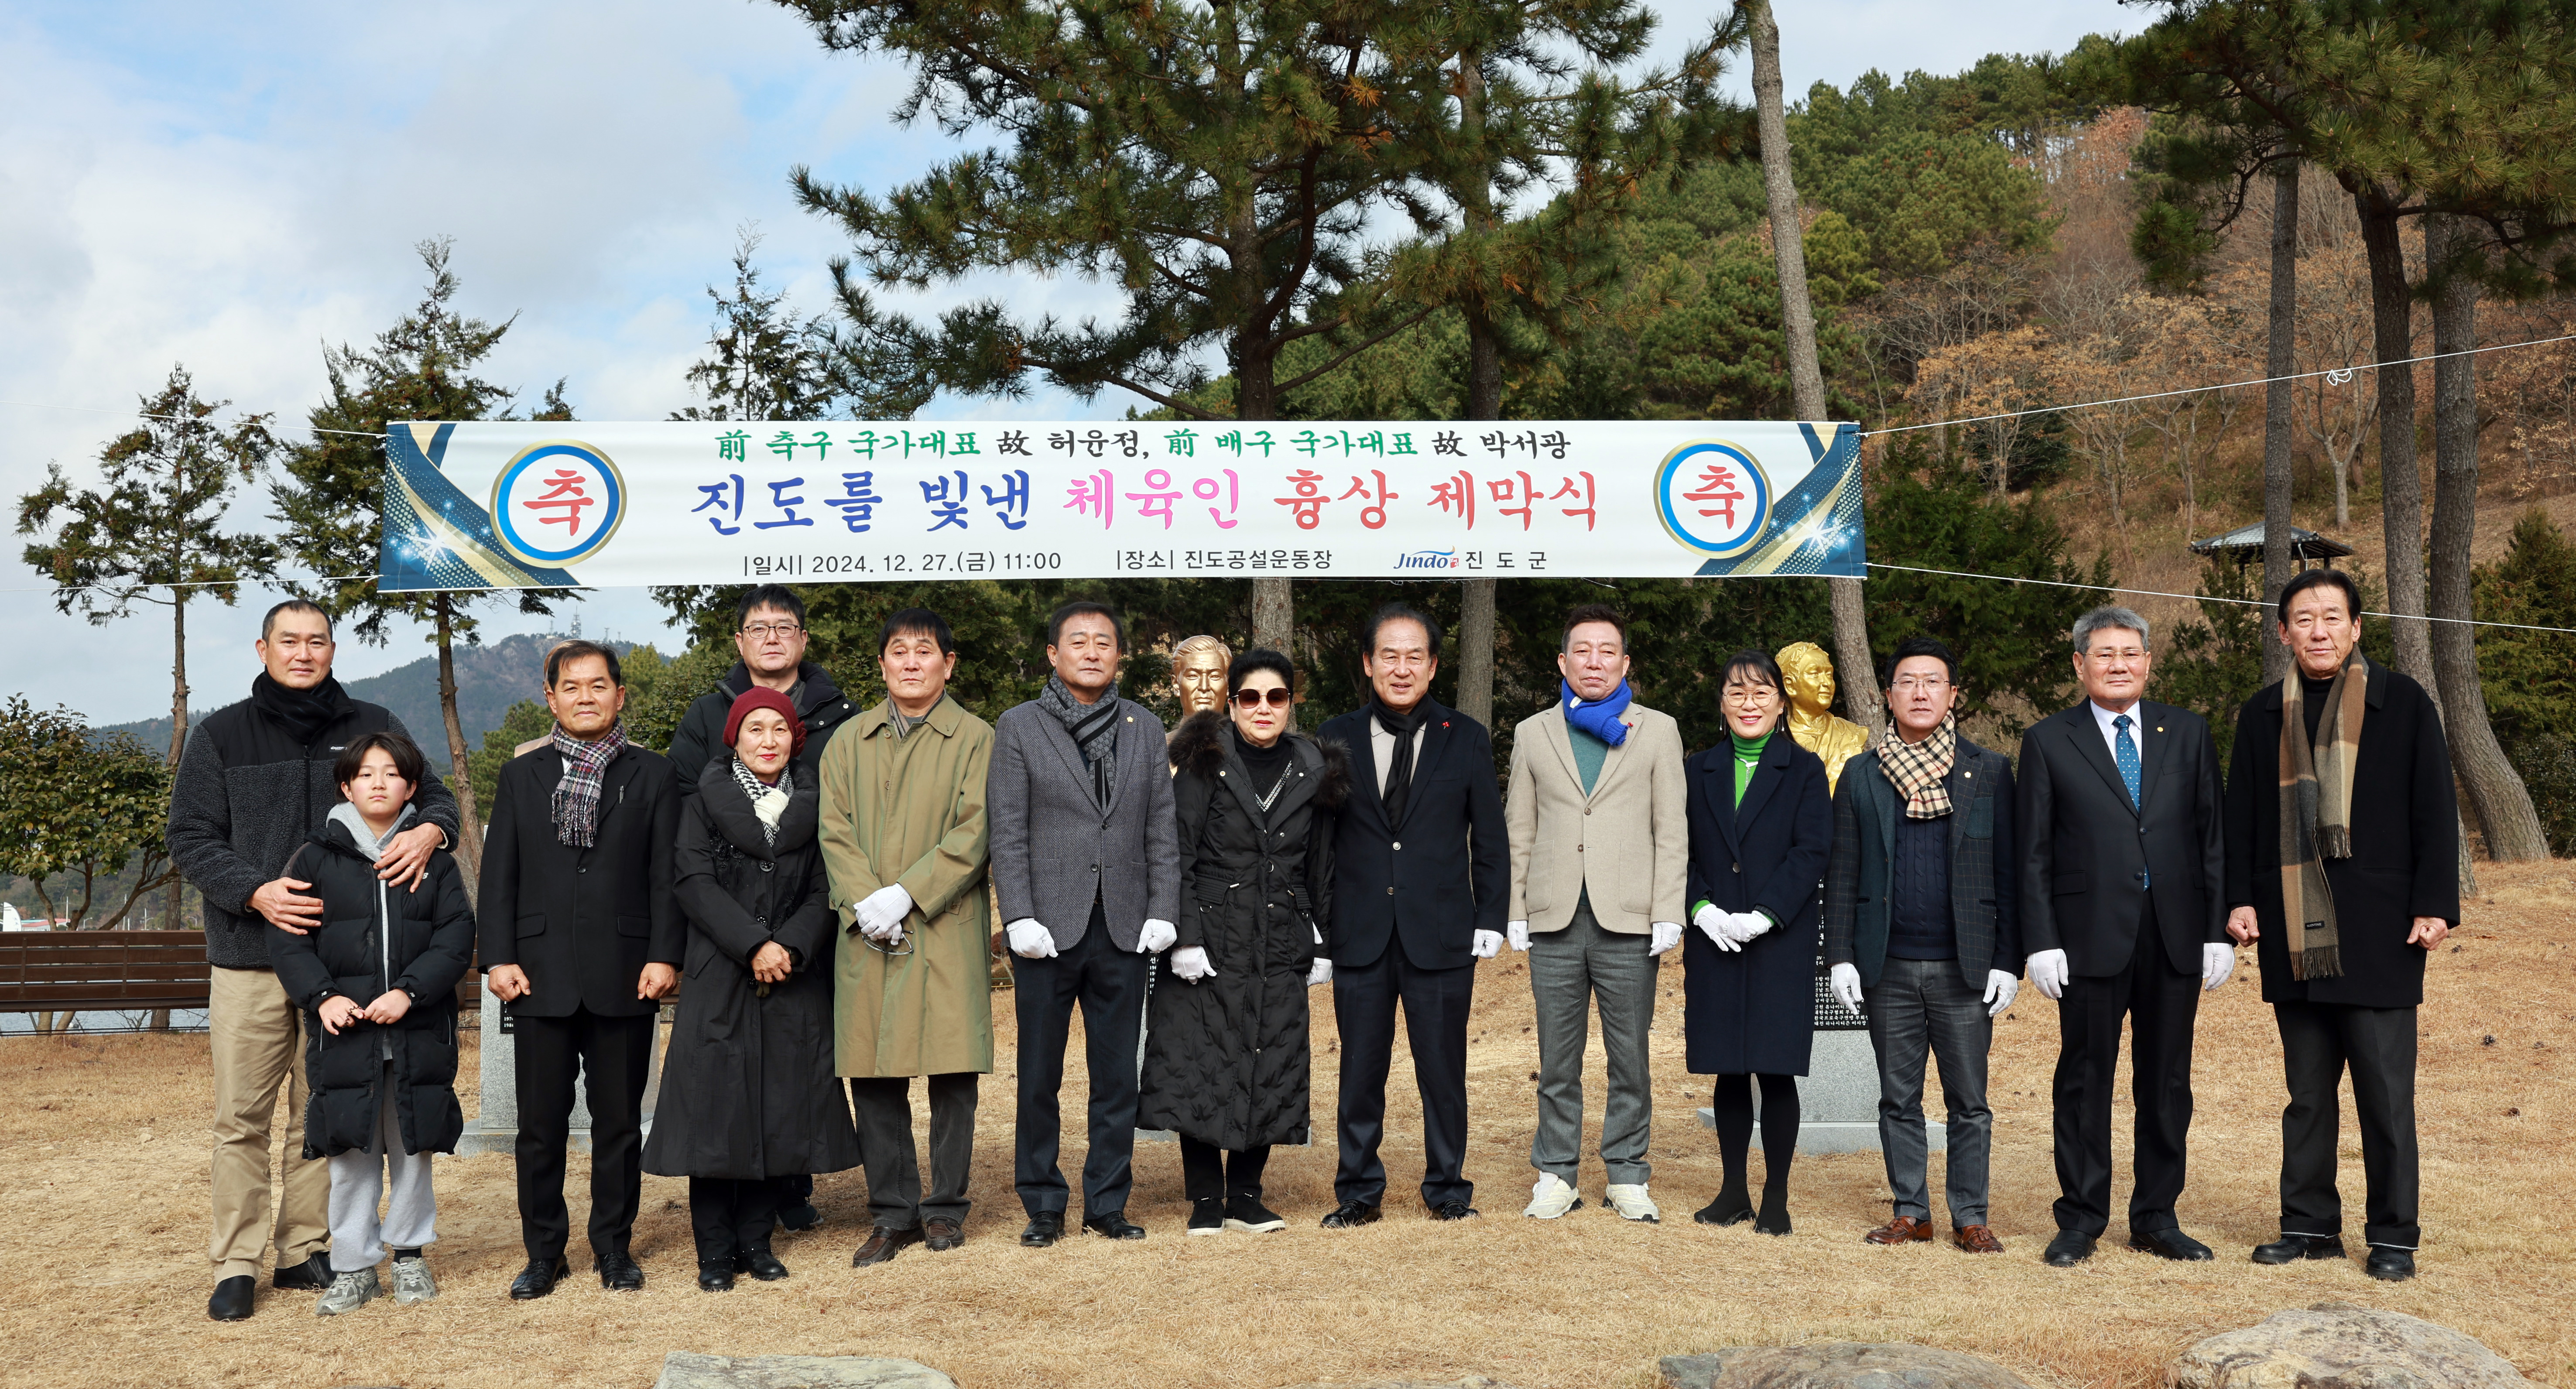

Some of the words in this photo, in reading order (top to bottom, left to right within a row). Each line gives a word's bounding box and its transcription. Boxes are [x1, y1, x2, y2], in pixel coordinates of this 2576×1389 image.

[716, 429, 751, 462] 前
[767, 431, 832, 461] 축구
[849, 430, 981, 459] 국가대표
[997, 430, 1032, 456] 故
[1048, 430, 1149, 459] 허윤정,
[1165, 428, 1199, 457] 前
[1216, 430, 1276, 458] 배구
[1291, 430, 1418, 457] 국가대표
[1432, 431, 1467, 456] 故
[1480, 431, 1571, 459] 박서광
[523, 469, 594, 536] 축
[692, 471, 883, 535] 진도를
[919, 469, 1029, 531] 빛낸
[1064, 469, 1239, 530] 체육인
[1274, 469, 1399, 530] 흉상
[1427, 470, 1596, 531] 제막식
[1682, 465, 1744, 530] 축
[812, 556, 874, 572] 2024.
[884, 554, 913, 572] 12.
[922, 551, 995, 572] 27.(금)
[1004, 553, 1061, 569] 11:00
[1185, 550, 1332, 569] 진도공설운동장
[1393, 553, 1448, 569] Jindo
